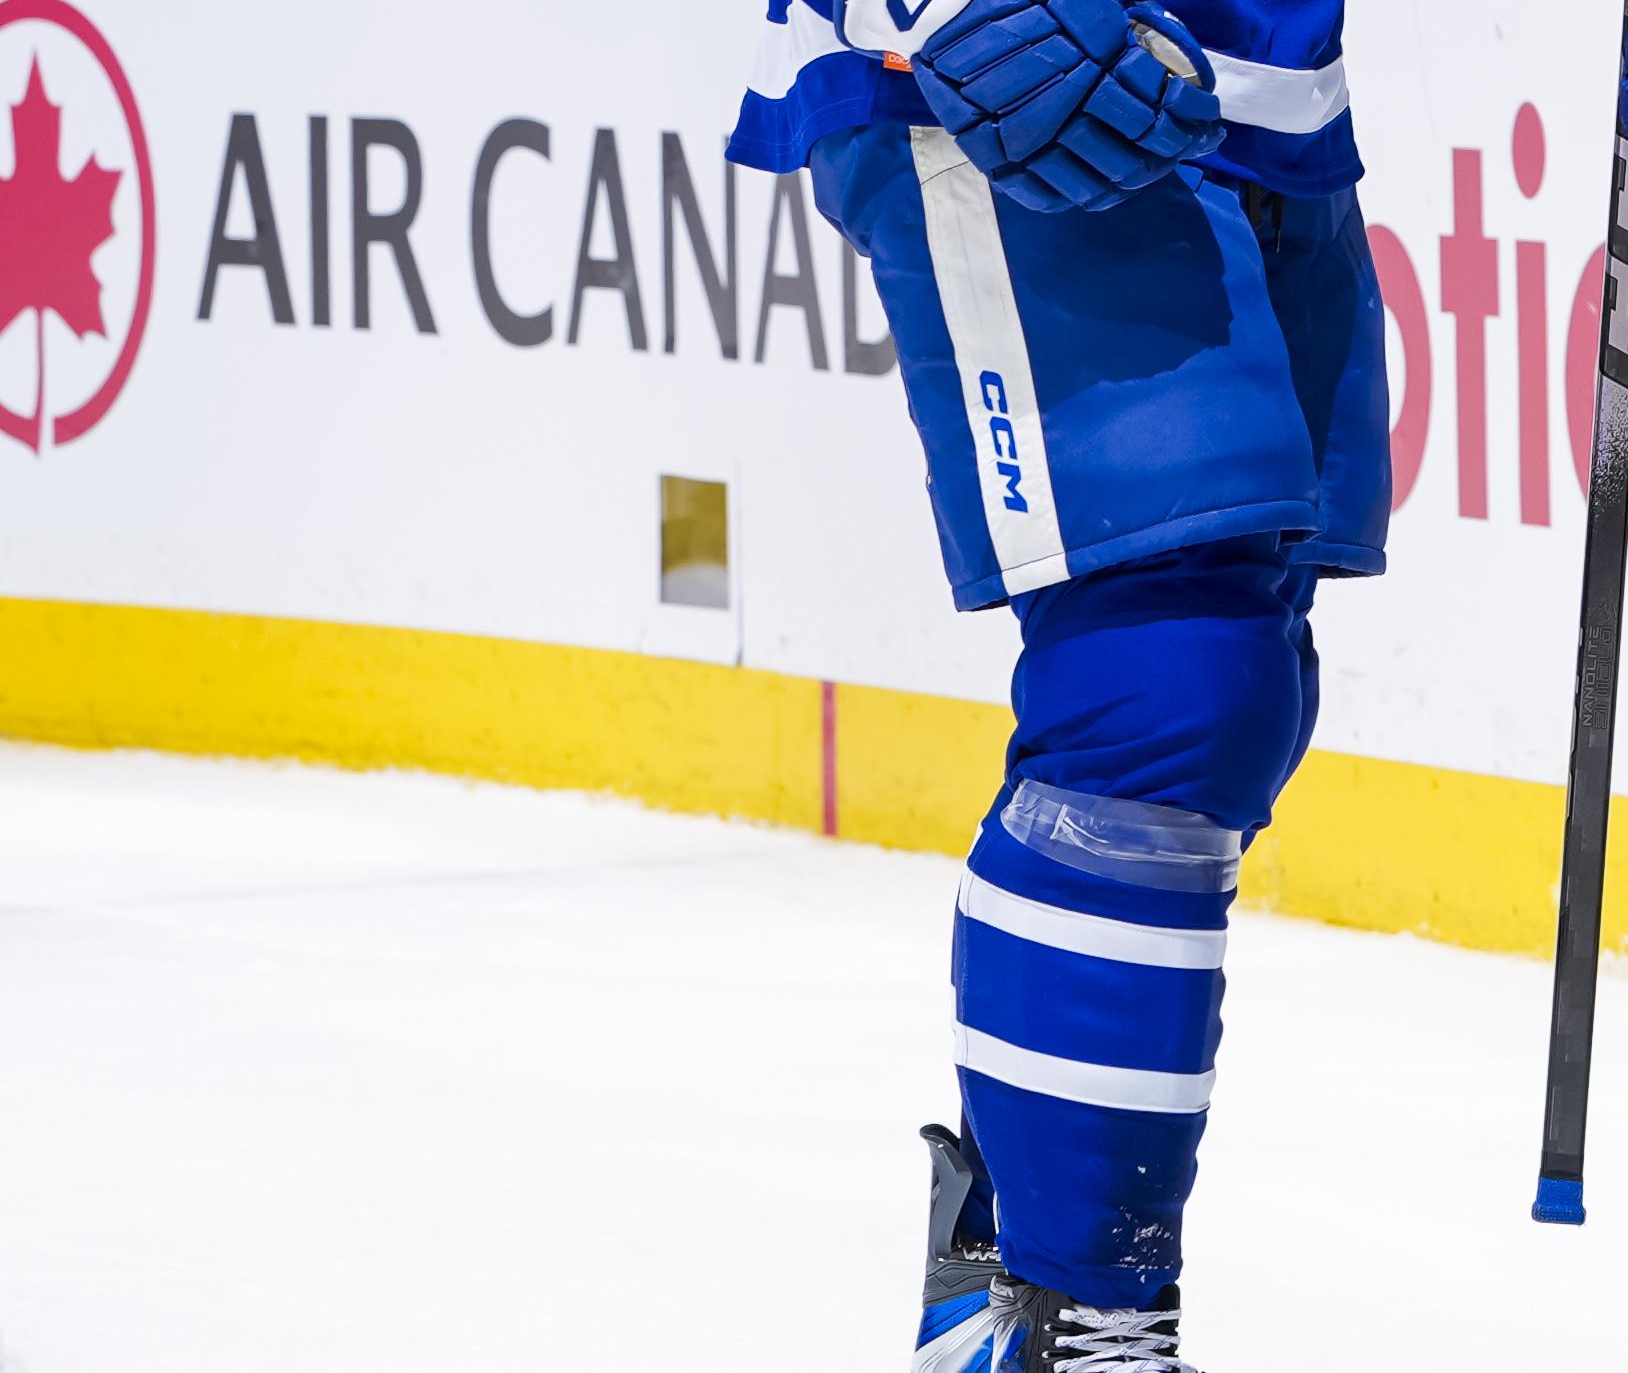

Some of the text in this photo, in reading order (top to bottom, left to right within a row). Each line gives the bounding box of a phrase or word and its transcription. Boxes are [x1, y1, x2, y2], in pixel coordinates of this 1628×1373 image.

[197, 113, 439, 335] AIR
[979, 369, 1029, 514] CCM
[1583, 625, 1600, 727] NANOLITE
